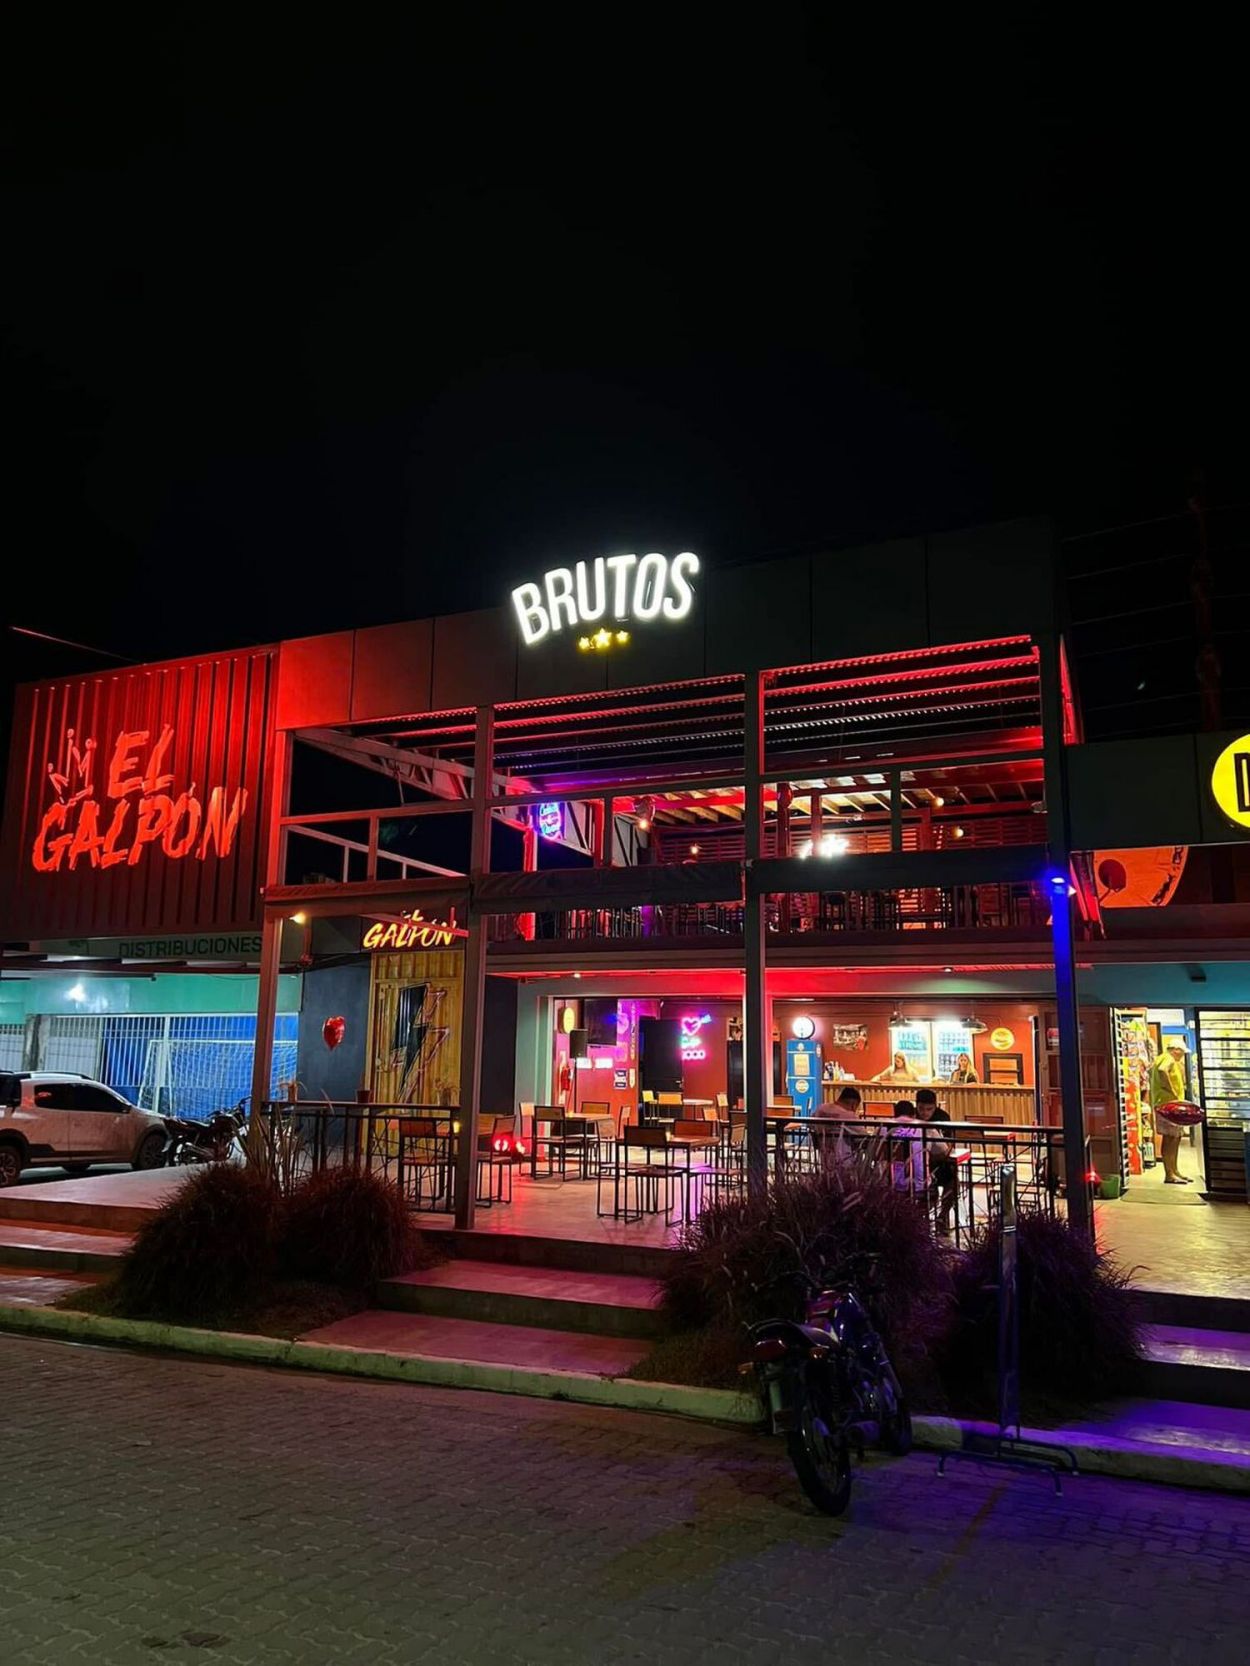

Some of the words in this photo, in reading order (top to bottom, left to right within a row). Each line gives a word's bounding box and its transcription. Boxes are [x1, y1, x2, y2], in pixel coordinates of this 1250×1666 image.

[511, 552, 701, 645] BRUTOS
[108, 723, 175, 799] EL
[32, 782, 248, 872] GALPÓN
[119, 937, 262, 959] DISTRIBUCIONES
